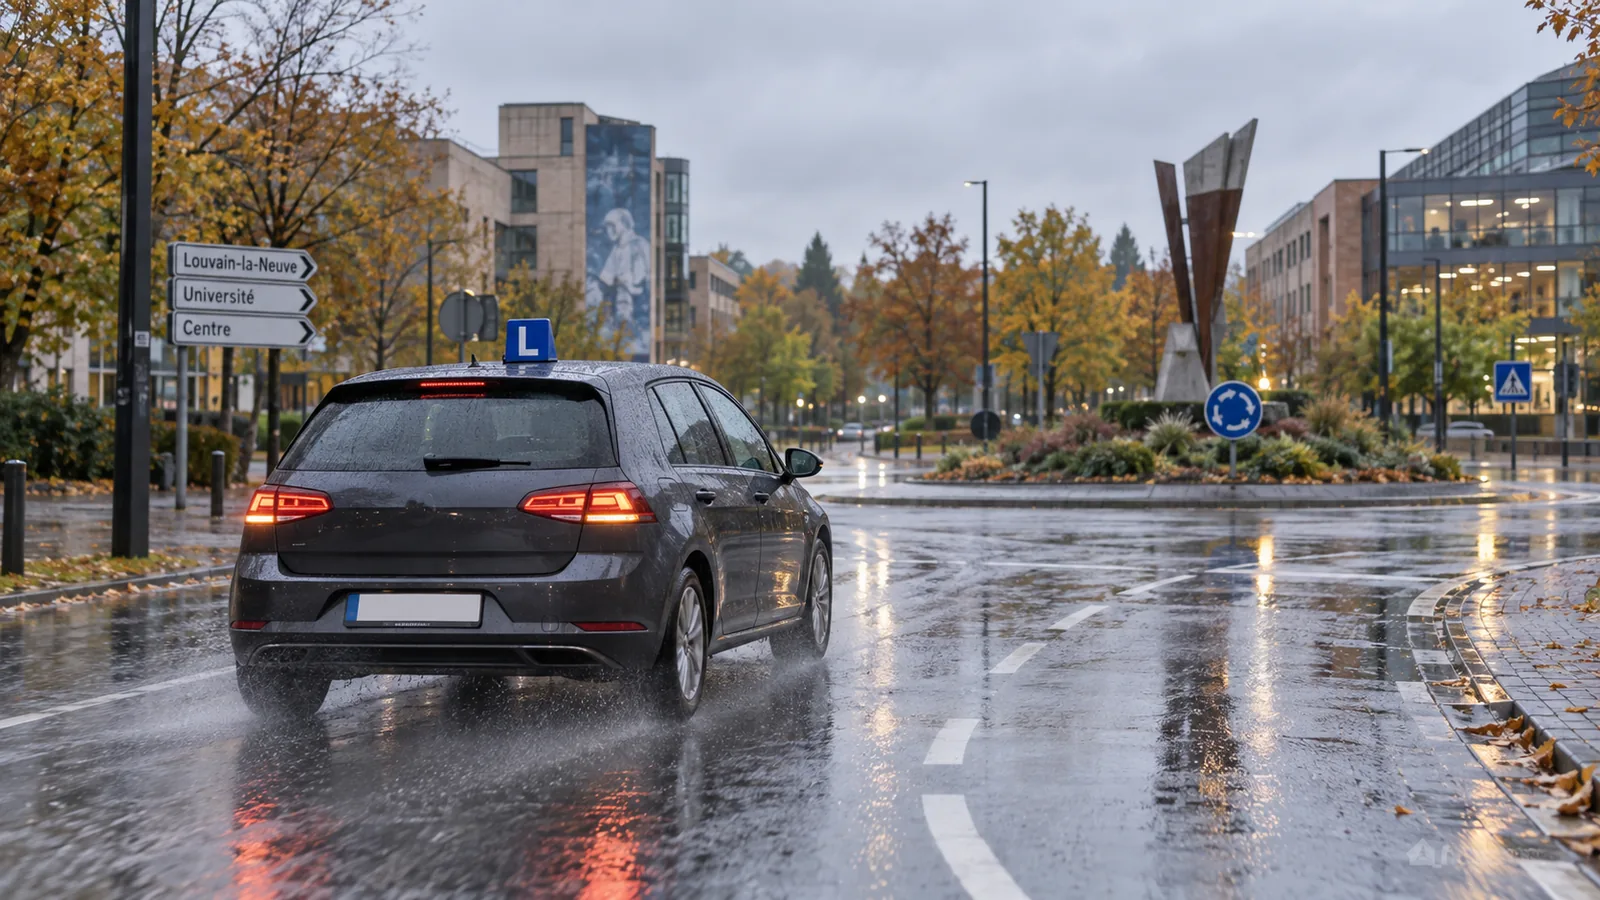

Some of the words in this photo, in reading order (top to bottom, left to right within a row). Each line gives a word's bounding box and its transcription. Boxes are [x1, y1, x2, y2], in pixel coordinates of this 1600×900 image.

[184, 252, 298, 274] Louvain-la-Neuve
[183, 286, 255, 304] Université
[183, 319, 231, 336] Centre
[518, 326, 539, 357] L
